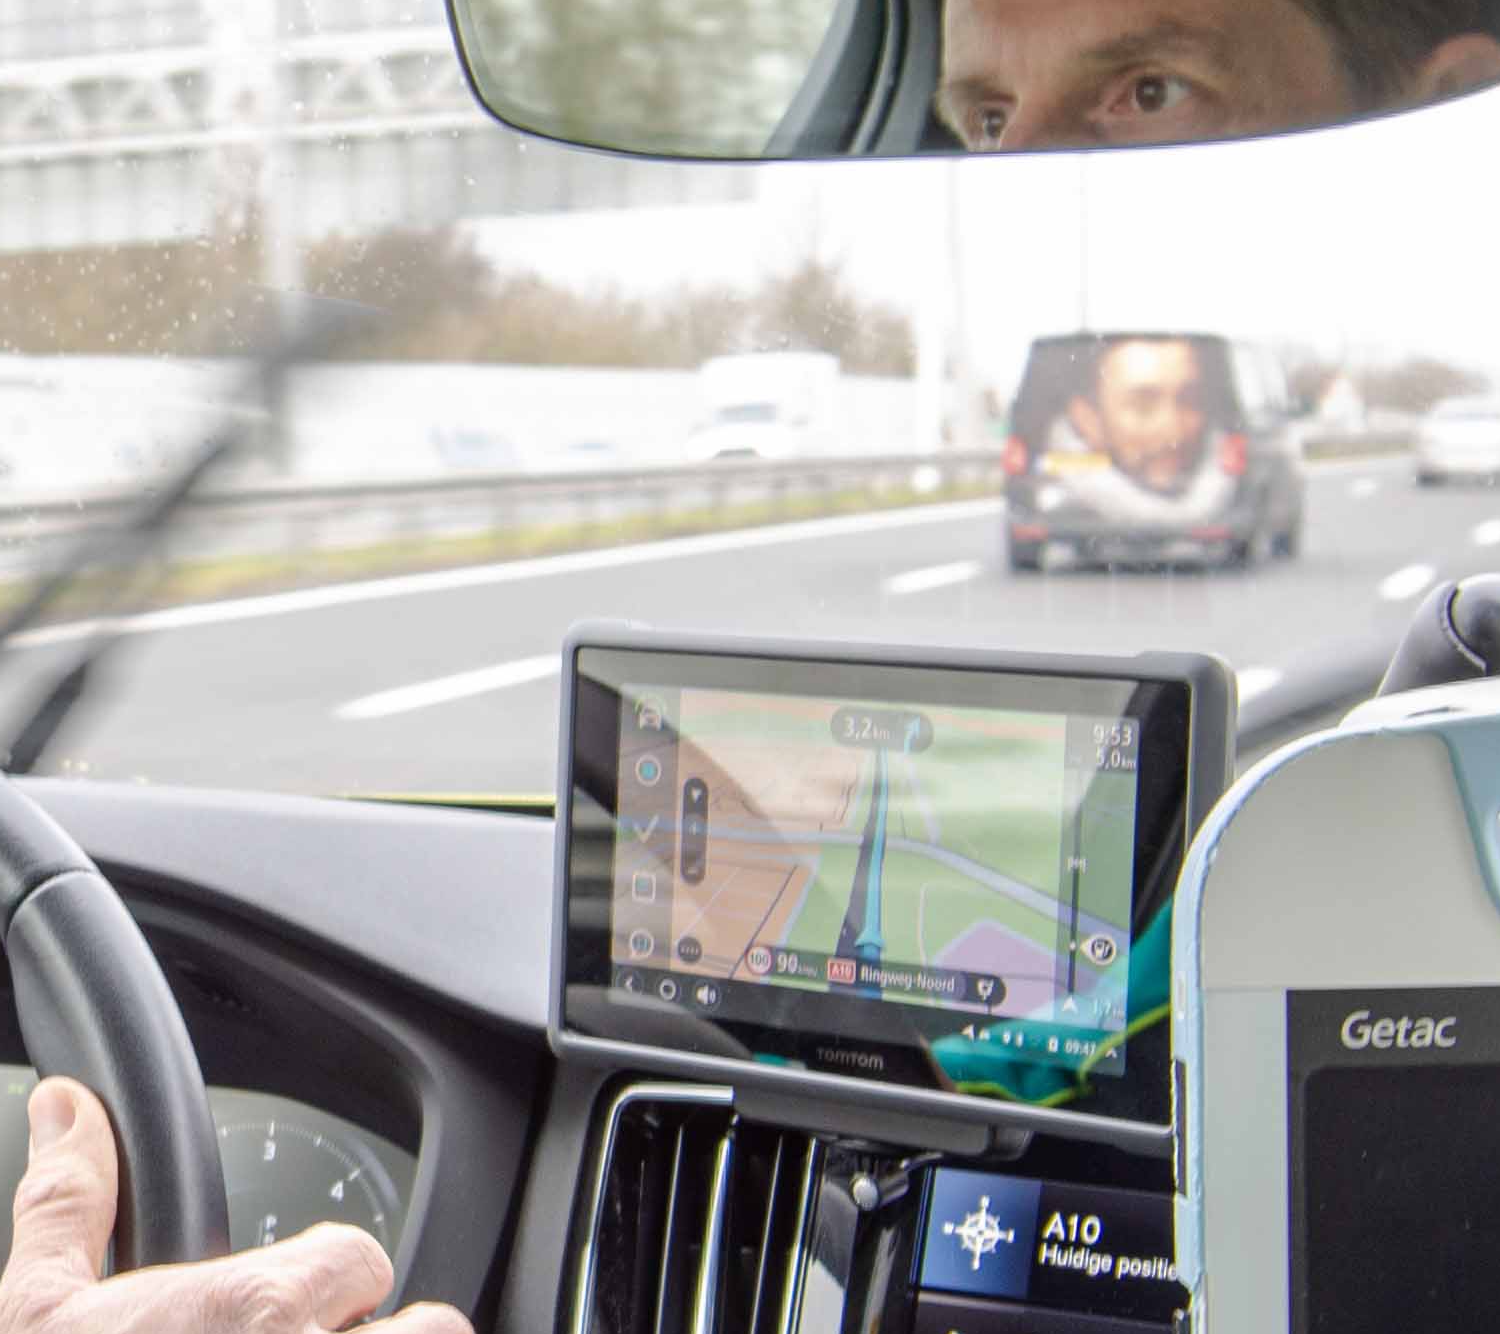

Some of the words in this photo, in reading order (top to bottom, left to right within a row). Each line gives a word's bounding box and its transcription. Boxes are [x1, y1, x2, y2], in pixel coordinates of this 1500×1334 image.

[1341, 1009, 1457, 1049] Getac
[1042, 1211, 1103, 1245] A10
[1038, 1242, 1112, 1277] Huidige
